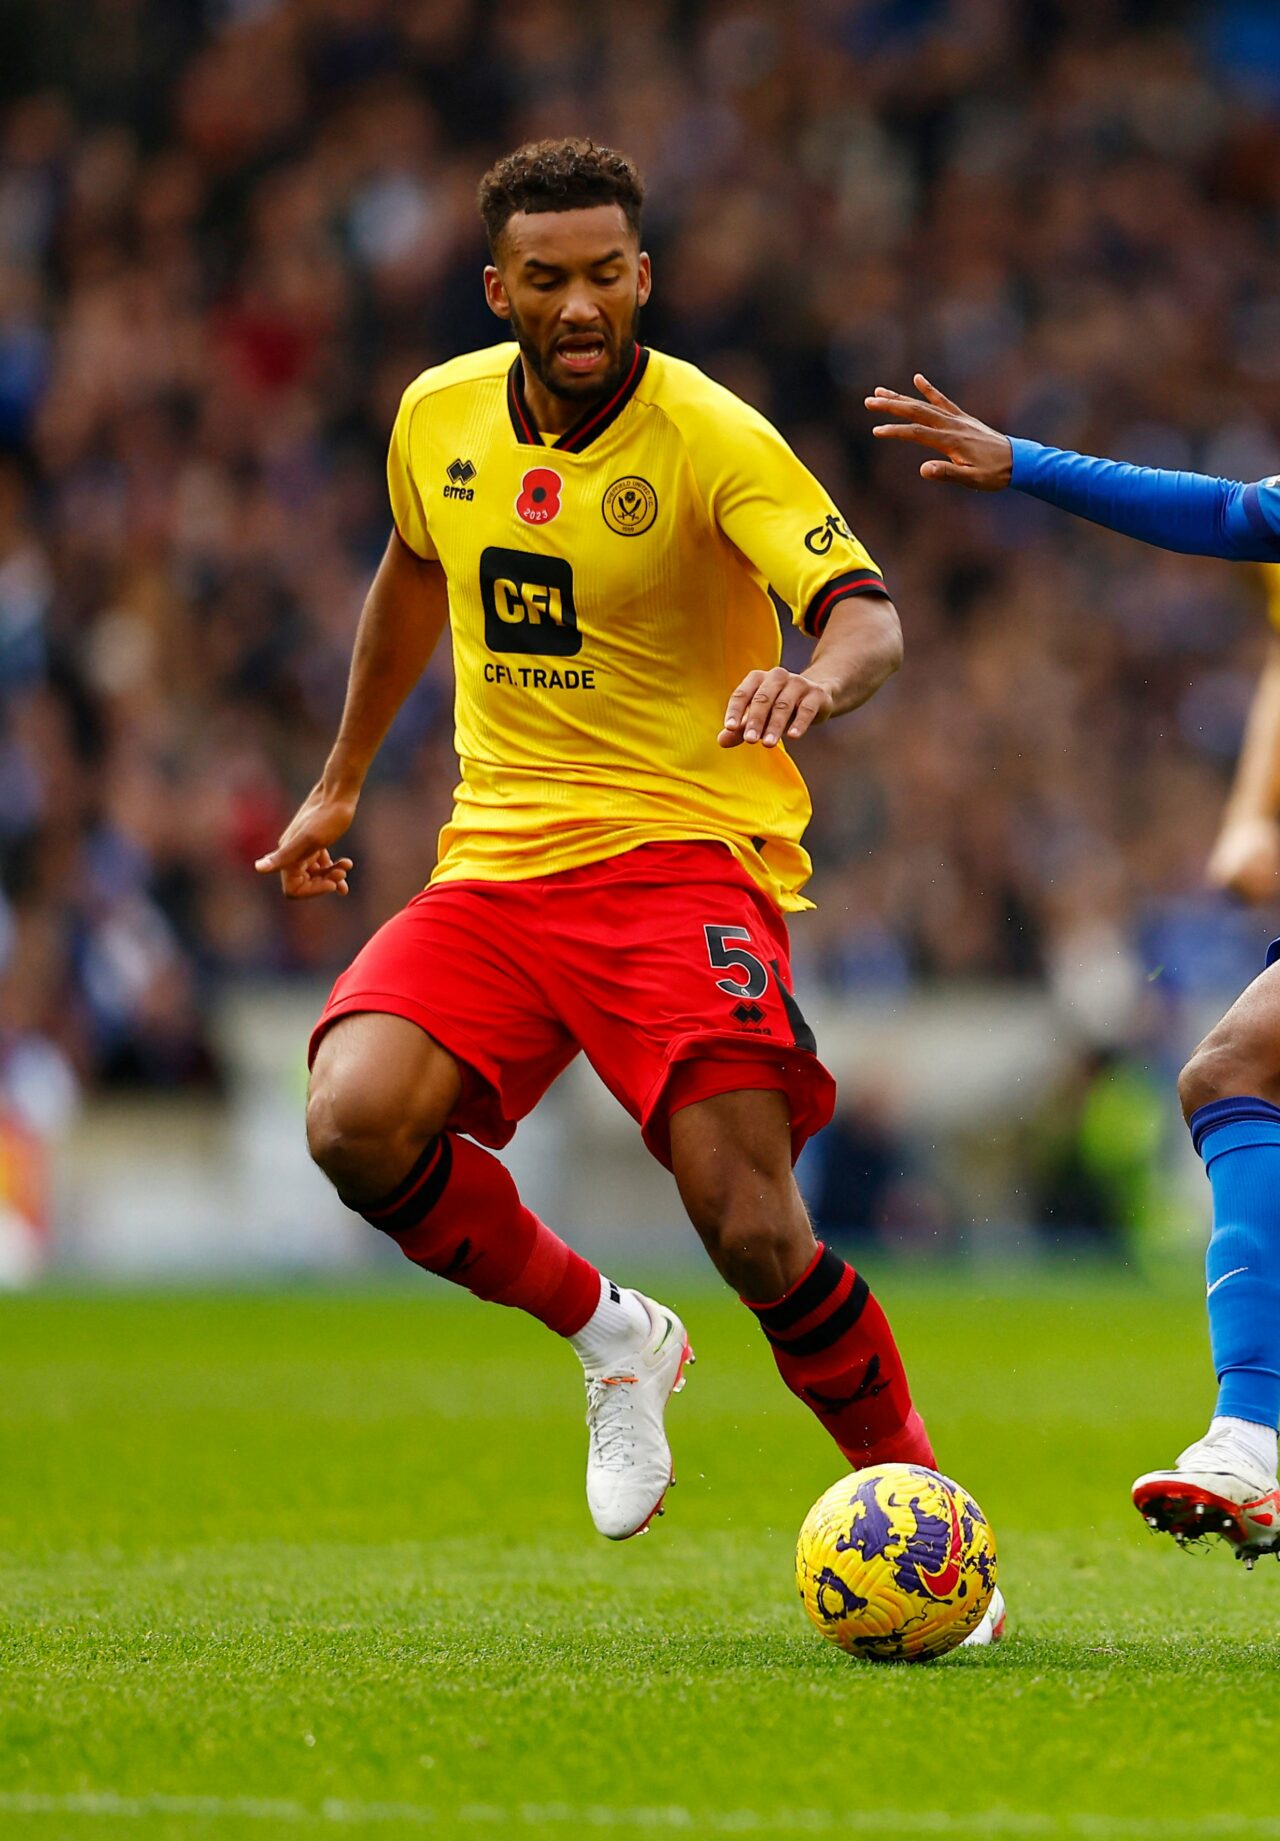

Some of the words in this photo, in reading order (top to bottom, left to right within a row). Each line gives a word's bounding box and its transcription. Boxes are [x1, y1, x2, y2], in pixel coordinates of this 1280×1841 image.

[443, 485, 475, 502] errea
[523, 507, 549, 521] 2023
[493, 578, 564, 627] CFI
[484, 663, 596, 690] CFI.TRADE
[703, 924, 769, 1000] 5
